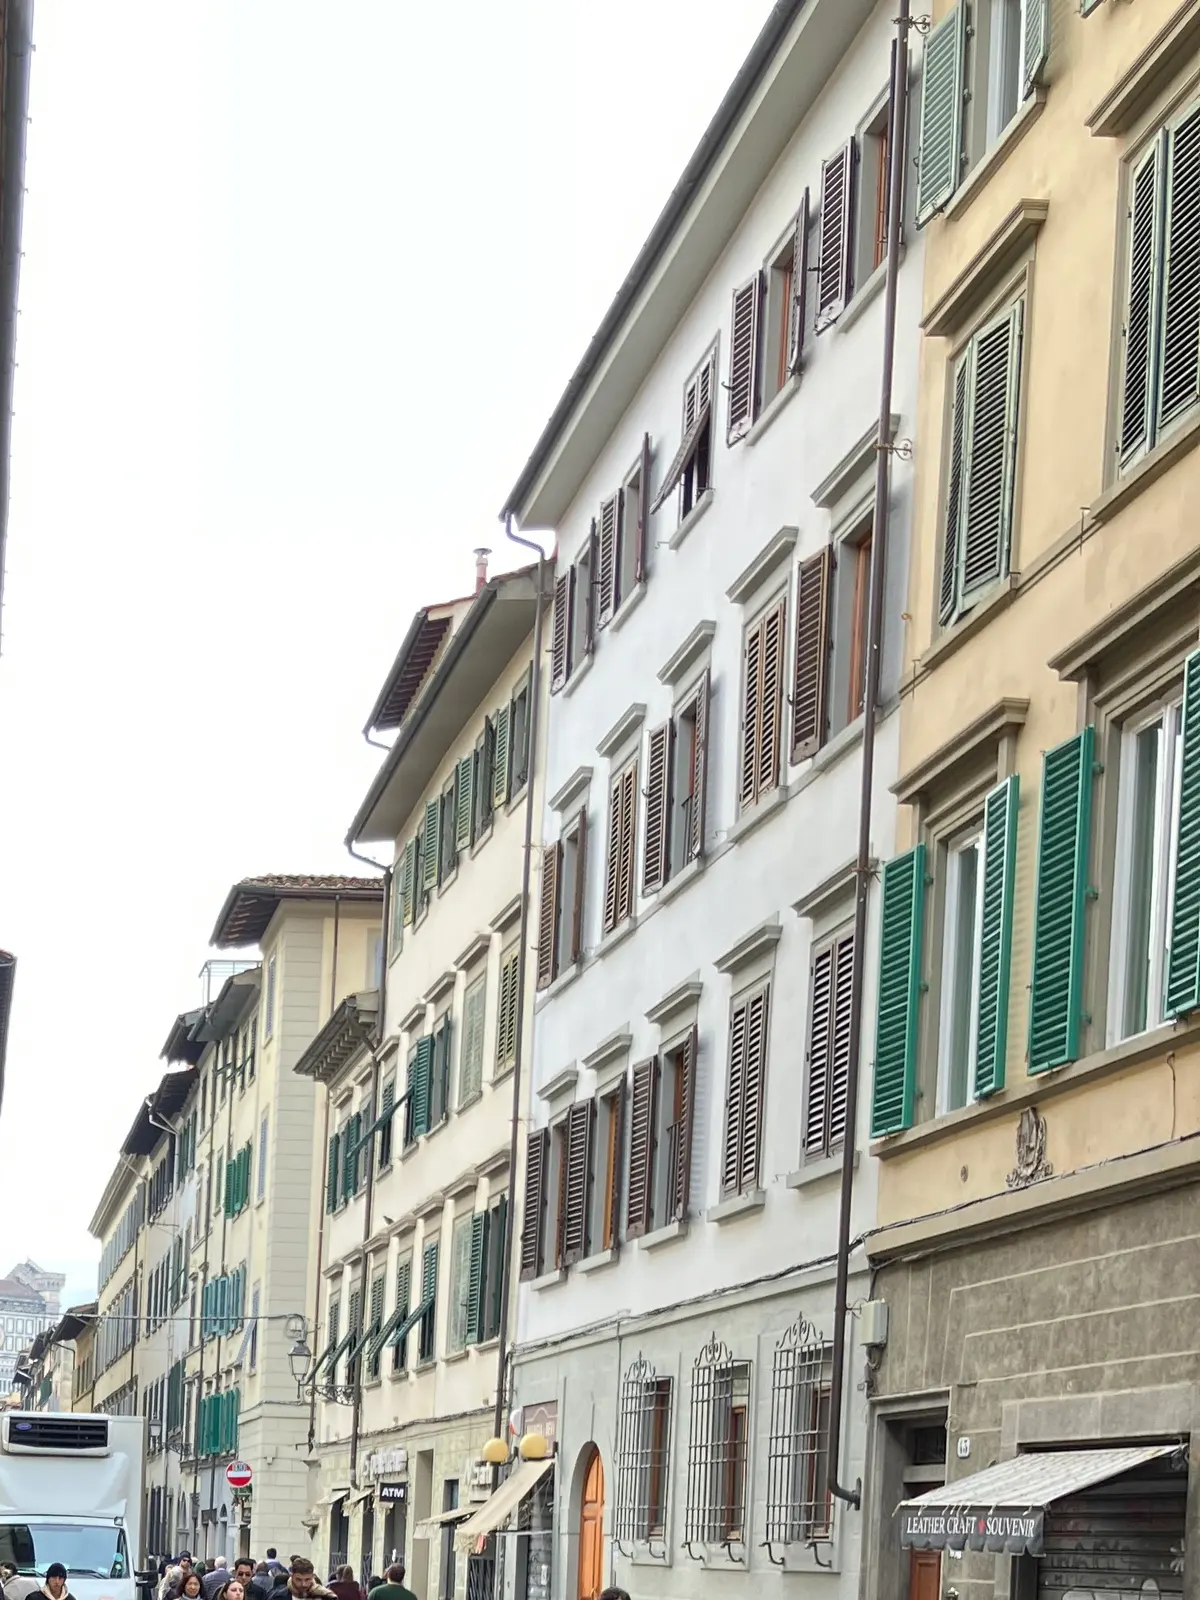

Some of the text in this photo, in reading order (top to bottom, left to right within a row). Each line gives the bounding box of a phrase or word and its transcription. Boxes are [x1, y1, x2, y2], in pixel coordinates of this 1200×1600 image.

[382, 1487, 404, 1498] ATM
[907, 1515, 1035, 1538] LEATHER CRAFT SOUVENIR
